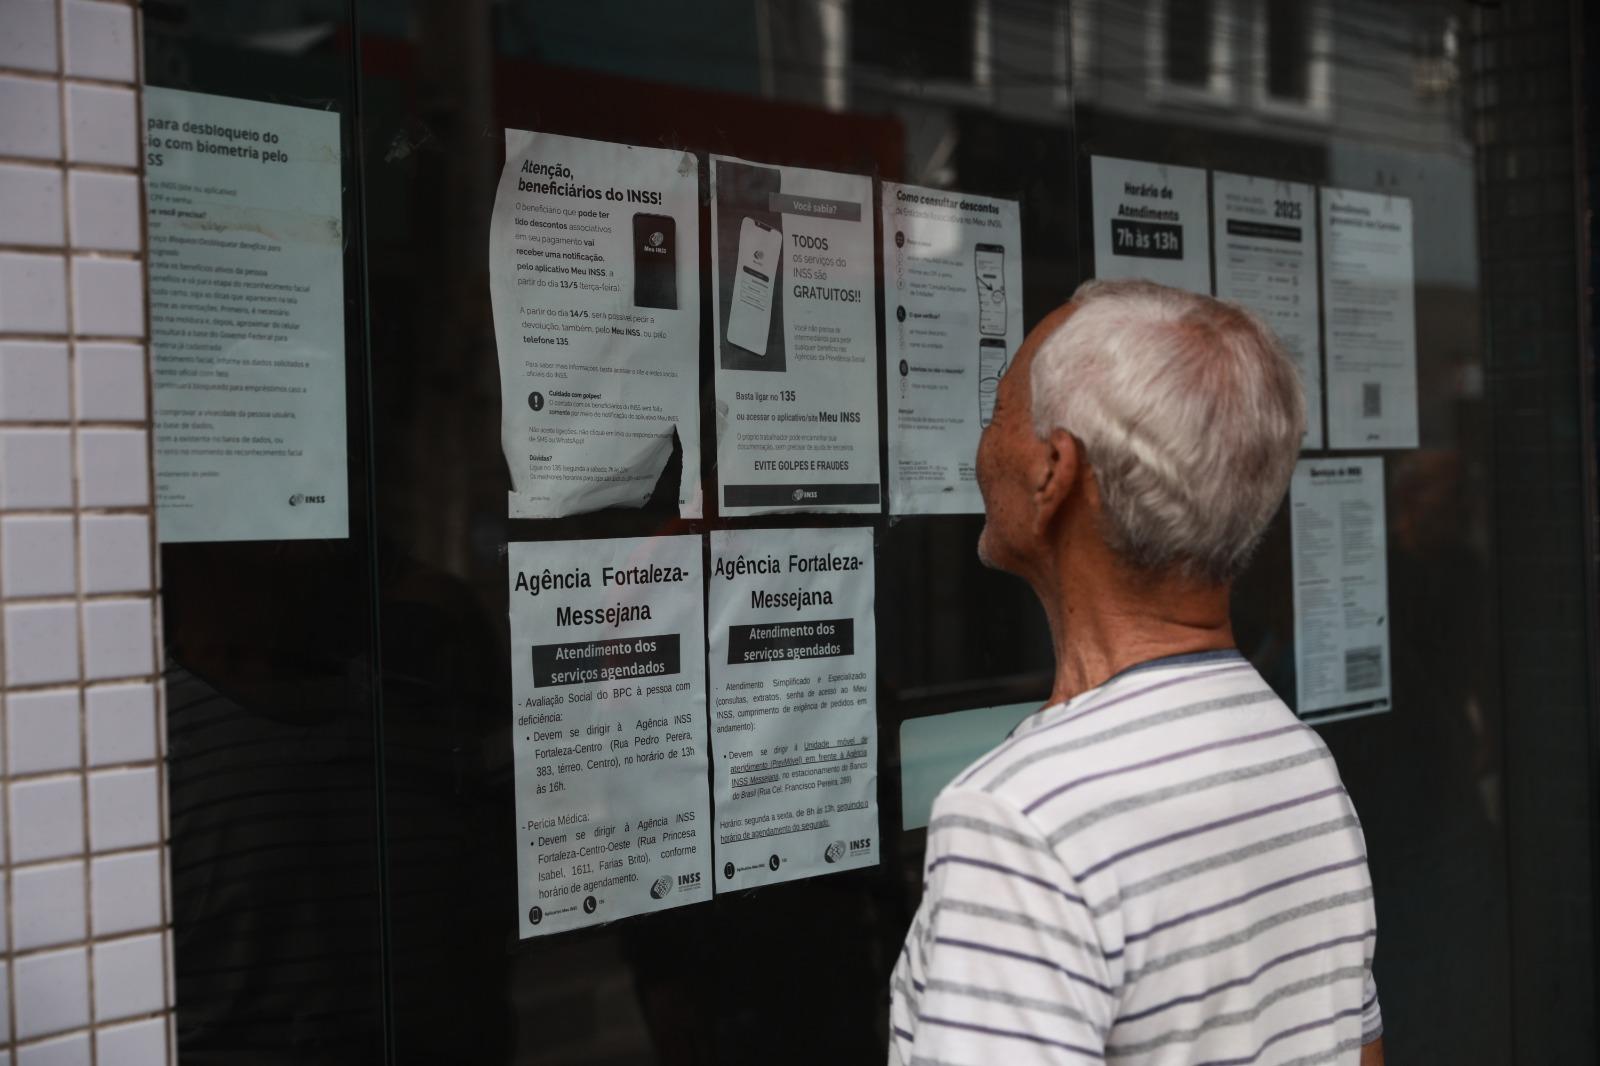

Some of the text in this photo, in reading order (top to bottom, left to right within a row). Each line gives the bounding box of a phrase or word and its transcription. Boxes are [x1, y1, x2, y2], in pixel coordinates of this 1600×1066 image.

[148, 119, 279, 144] para desbloqueio do
[165, 139, 194, 151] com
[197, 140, 259, 160] biometria
[262, 150, 288, 163] pelo
[522, 160, 574, 180] Atenção,
[519, 179, 662, 206] beneficiários do INSS!
[1125, 184, 1173, 200] Horário de
[522, 202, 562, 215] beneficiário
[578, 210, 598, 219] pode
[599, 211, 610, 219] ter
[794, 201, 837, 214] Você sabia?
[897, 190, 999, 215] Como consultar descontos
[1274, 200, 1302, 220] 2025
[1118, 204, 1179, 222] Atendimento
[515, 218, 612, 234] tido descontos associativos
[529, 235, 541, 243] seu
[542, 237, 583, 246] pagamento
[792, 234, 829, 251] TODOS
[1118, 228, 1178, 250] 7h às 13h
[517, 249, 544, 257] receber
[793, 254, 847, 268] os serviços do
[517, 263, 534, 272] pelo
[535, 265, 570, 274] aplicativo
[571, 267, 587, 275] Meu
[794, 267, 828, 281] INSS são
[537, 279, 547, 287] do
[548, 280, 559, 288] dia
[561, 281, 578, 289] 13/5
[794, 285, 861, 303] GRATUITOS!!
[527, 308, 546, 316] partir
[547, 309, 557, 317] do
[524, 336, 569, 346] telefone 135
[736, 392, 754, 401] Basta
[756, 393, 769, 403] ligar
[780, 391, 796, 402] 135
[778, 413, 818, 423] aplicativo/site
[819, 412, 838, 423] Meu
[841, 412, 861, 423] INSS
[755, 461, 849, 471] EVITE GOLPES E FRAUDES
[715, 553, 864, 581] Agência Fortaleza-
[515, 564, 689, 596] Agência Fortaleza-
[752, 588, 833, 611] Messejana
[557, 603, 652, 628] Messejana
[750, 623, 835, 640] Atendimento dos
[556, 640, 657, 660] Atendimento dos
[744, 643, 841, 661] serviços agendados
[552, 661, 665, 684] serviços agendados
[726, 682, 764, 691] Atendimento
[773, 677, 811, 688] Simplificado
[828, 672, 867, 684] Especializado
[526, 683, 691, 708] Avaliação Social do BPC à pessoa com
[519, 712, 563, 726] deficiência:
[534, 714, 692, 742] Devem se dirigir à Agência INSS
[535, 744, 603, 760] Fortaleza-Centro
[611, 740, 629, 752] (Rua
[635, 736, 660, 747] Pedro
[587, 757, 621, 770] Centro),
[625, 757, 634, 765] no
[637, 751, 665, 763] horário
[668, 749, 678, 759] de
[682, 747, 695, 757] 13h
[537, 785, 547, 795] às
[528, 814, 590, 831] Perícia Médica:
[539, 812, 696, 847] Devem se dirigir à Agência INSS
[539, 830, 696, 864] Fortaleza-Centro-Oeste (Rua Princesa
[851, 839, 871, 850] INSS
[600, 860, 624, 871] Farias
[661, 846, 697, 859] conforme
[539, 874, 639, 899] horário de agendamento.
[679, 872, 701, 886] INSS
